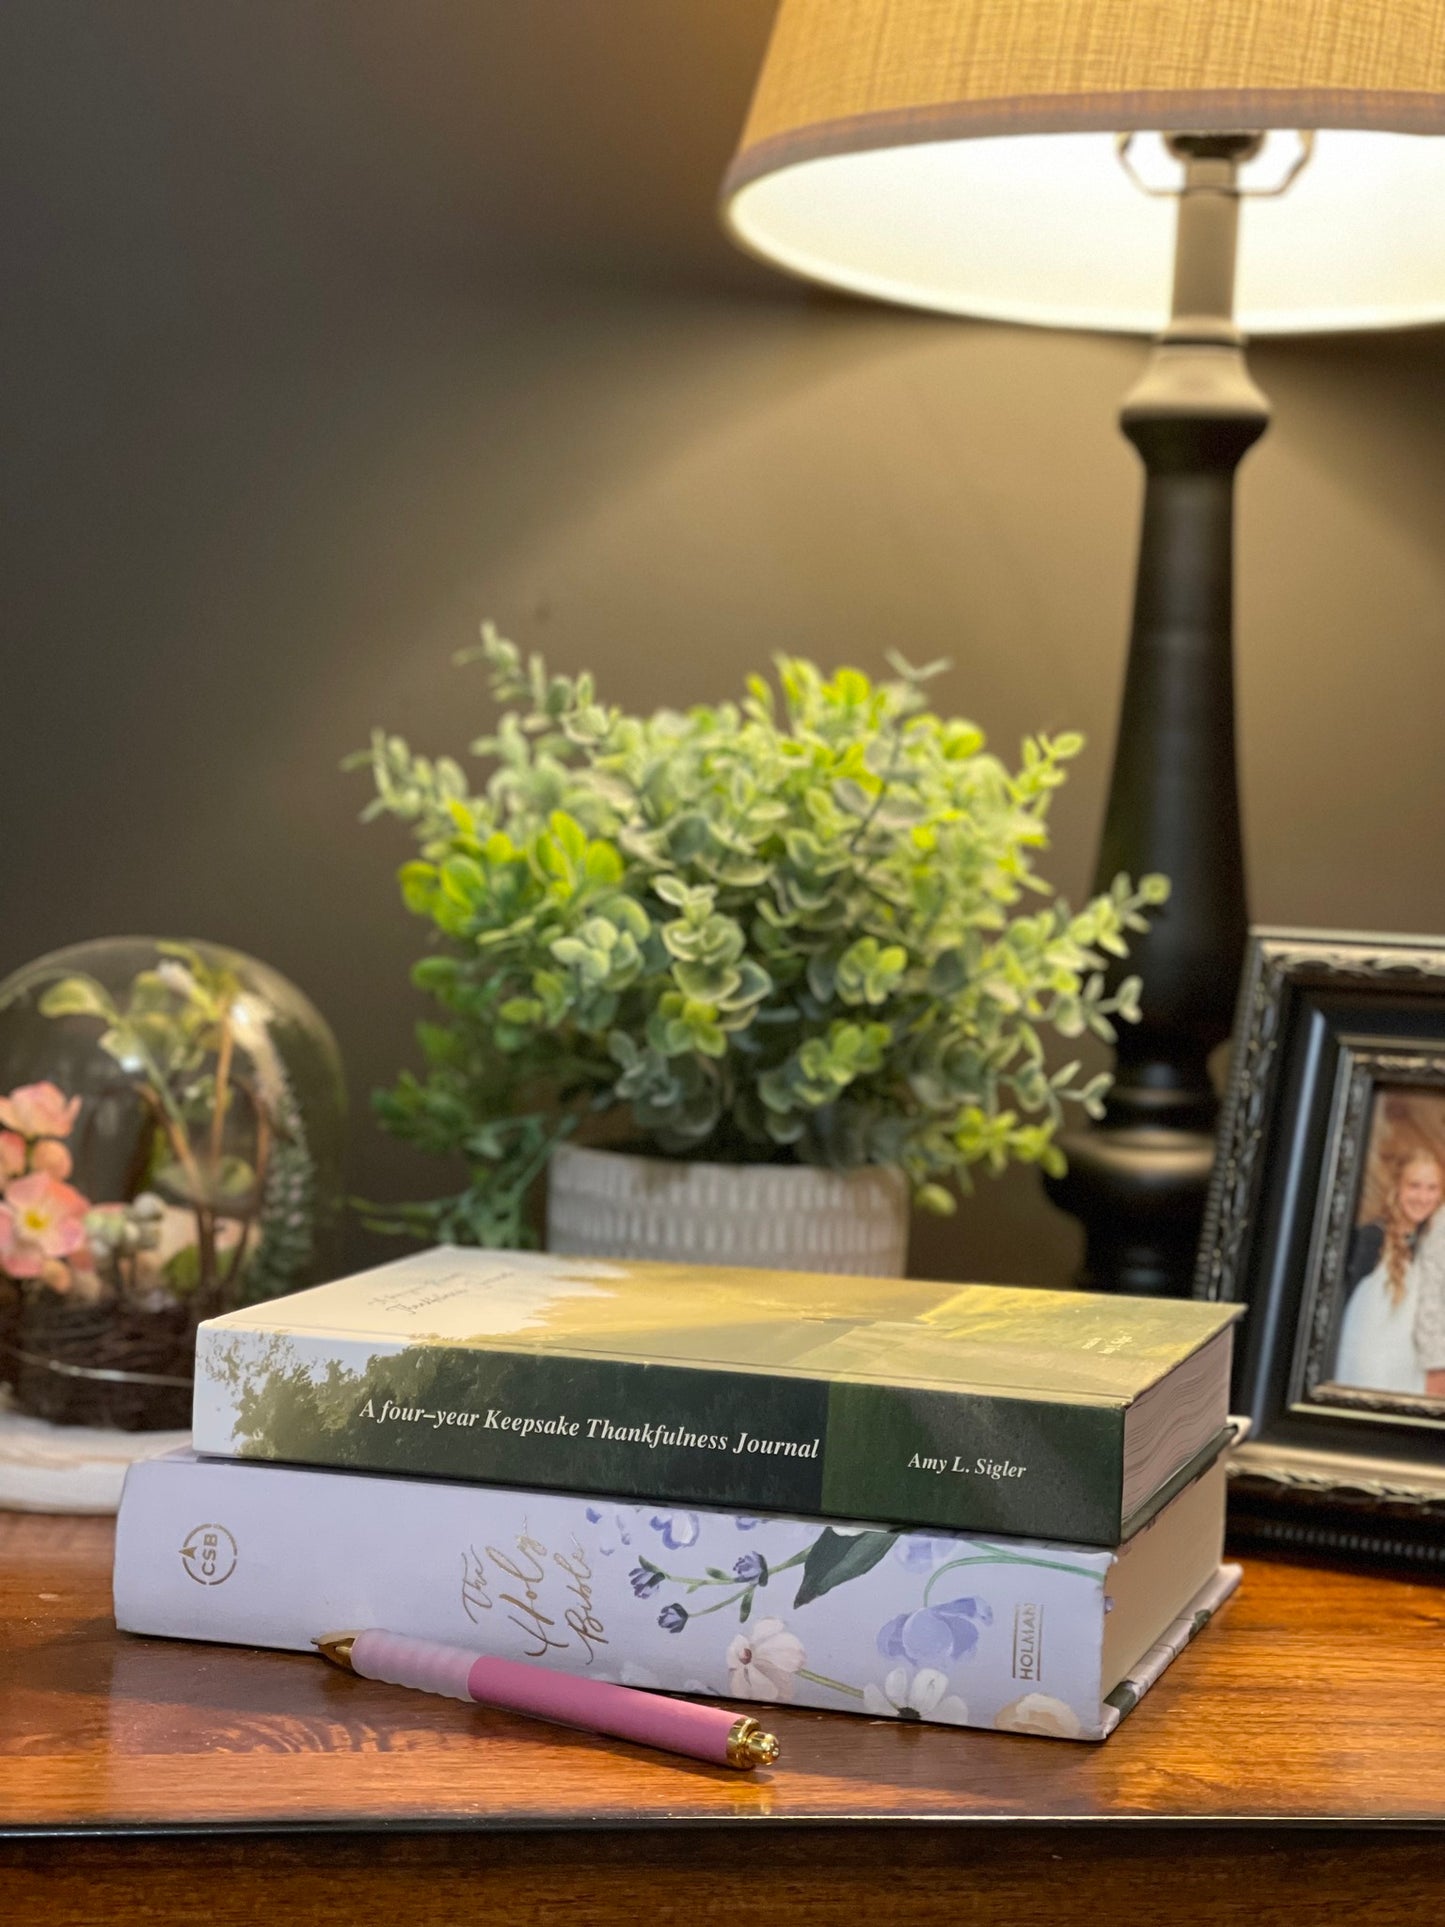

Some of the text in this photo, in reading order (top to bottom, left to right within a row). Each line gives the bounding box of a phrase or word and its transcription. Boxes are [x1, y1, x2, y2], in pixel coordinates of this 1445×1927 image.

[359, 1399, 375, 1418] A
[483, 1409, 580, 1437] Keepsake
[586, 1418, 728, 1449] Thankfulness
[732, 1432, 821, 1459] Journal
[907, 1453, 1027, 1480] Amy L. Sigler
[201, 1533, 218, 1576] CSB
[461, 1544, 493, 1624] The
[485, 1514, 569, 1657] Holy
[553, 1532, 609, 1666] Bible
[1019, 1603, 1036, 1680] HOLMAN
